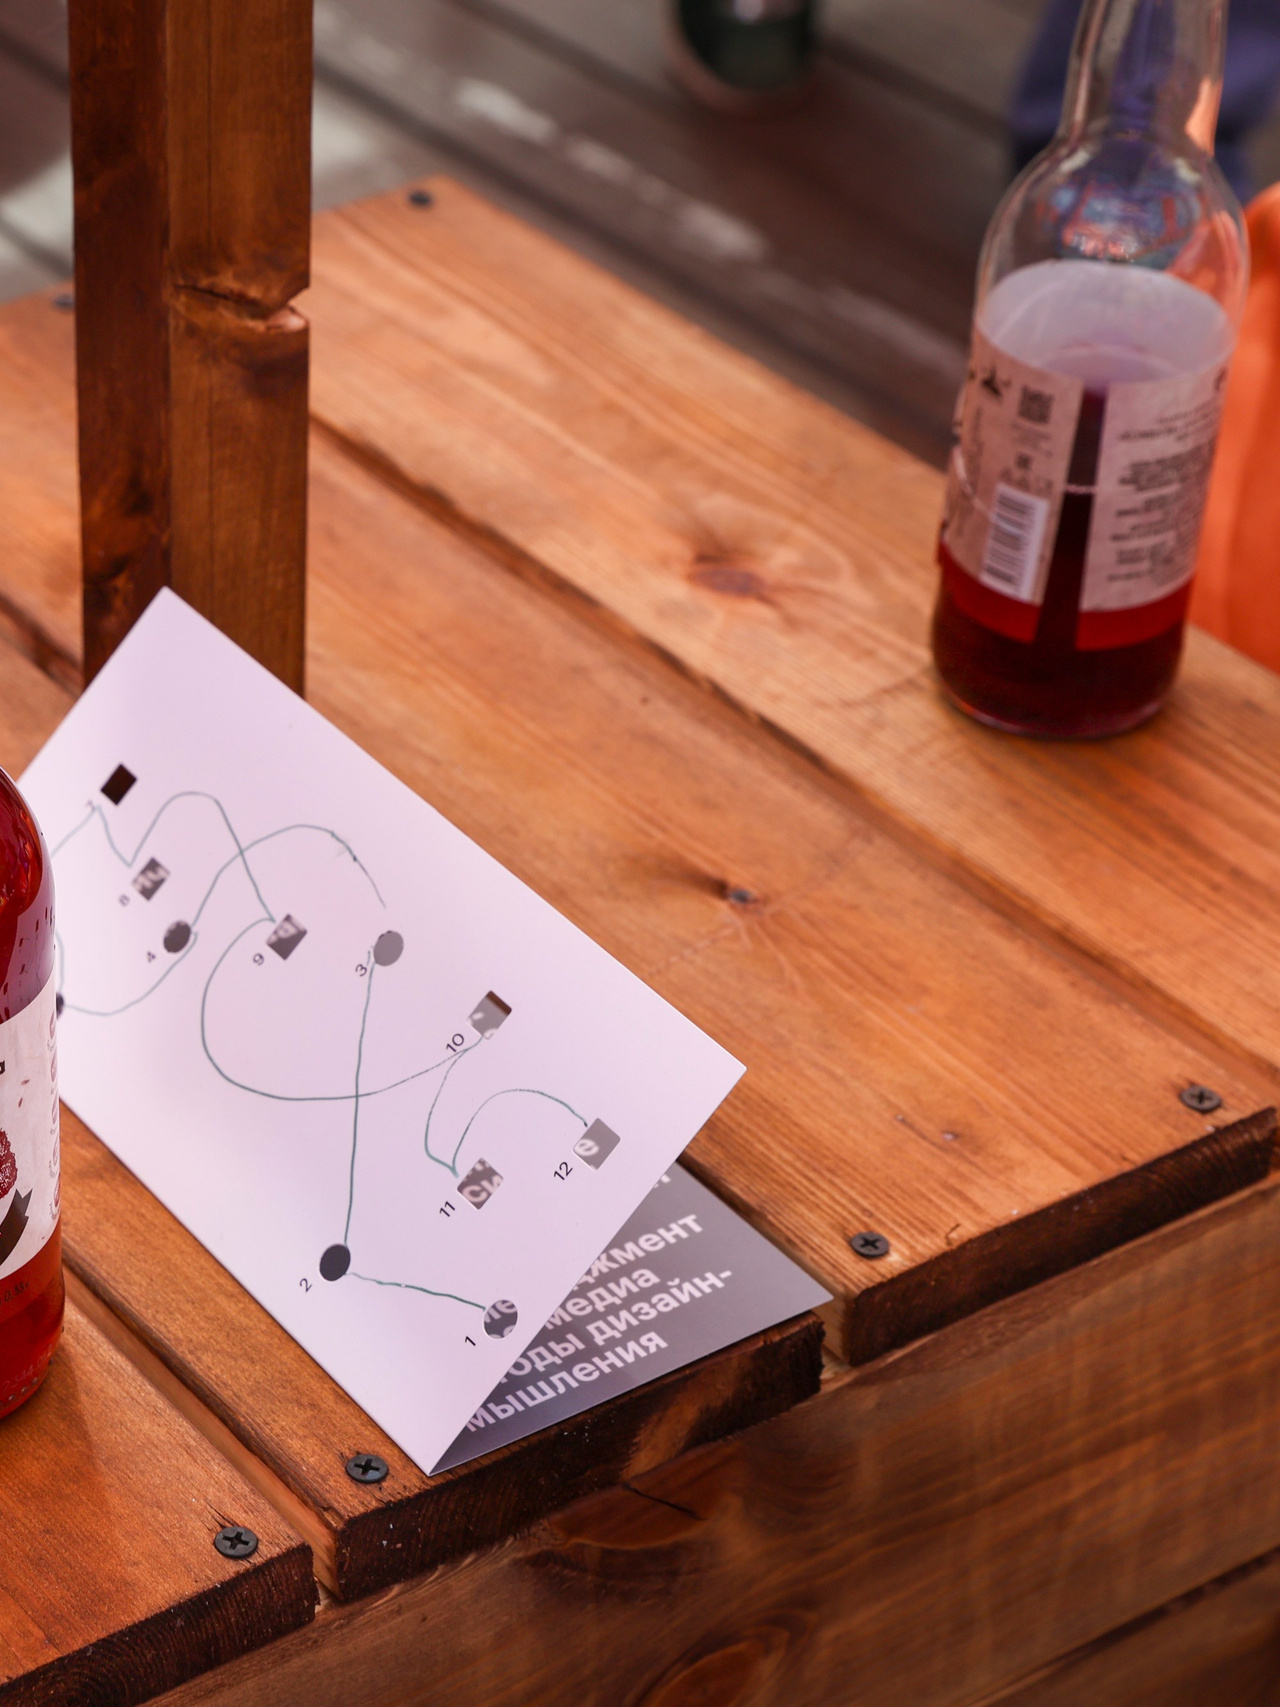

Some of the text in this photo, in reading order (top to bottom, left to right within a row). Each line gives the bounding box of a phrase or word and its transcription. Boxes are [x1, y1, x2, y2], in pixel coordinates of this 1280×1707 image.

[253, 953, 265, 966] 9
[355, 963, 368, 977] 3
[445, 1032, 466, 1054] 10
[553, 1160, 574, 1182] 12
[438, 1200, 457, 1219] 11
[299, 1278, 313, 1293] 2
[499, 1333, 586, 1384] оды
[586, 1269, 733, 1347] дизайн-
[464, 1335, 477, 1348] 1
[465, 1331, 669, 1433] мышления
